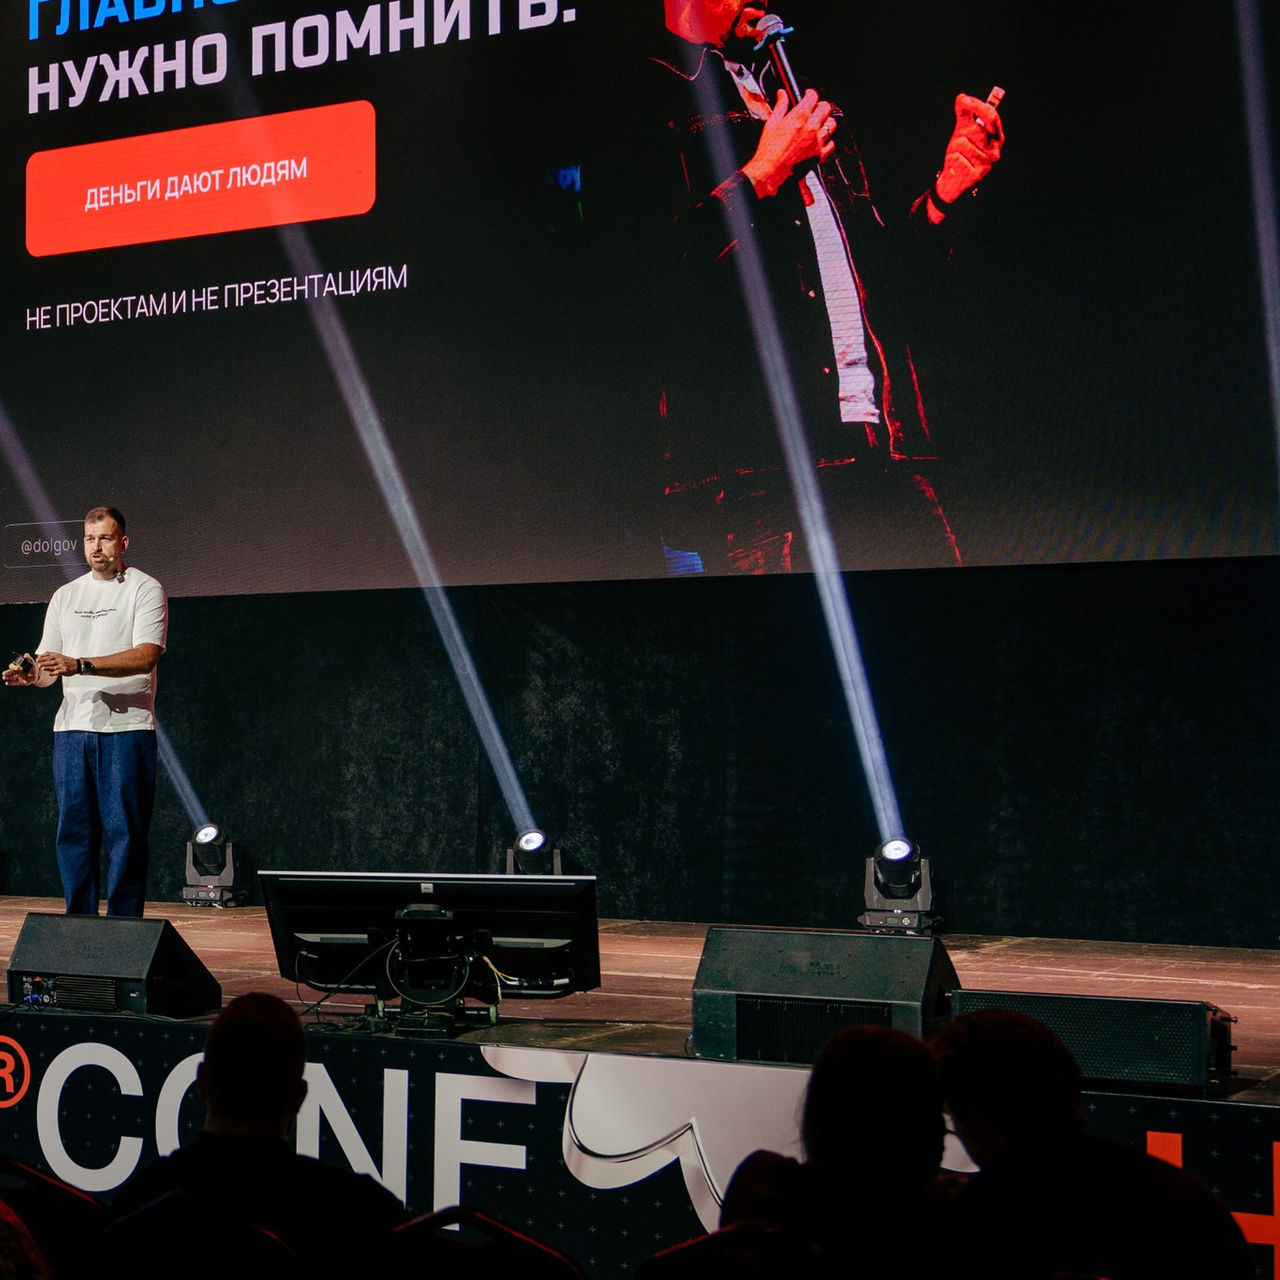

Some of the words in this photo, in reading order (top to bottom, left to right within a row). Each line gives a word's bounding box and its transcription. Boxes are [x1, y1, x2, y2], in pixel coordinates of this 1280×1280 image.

[28, 32, 228, 115] НУЖНО
[84, 178, 161, 212] ДЕНЬГИ
[164, 169, 224, 201] ДАЮТ
[226, 156, 308, 189] ЛЮДЯМ
[26, 305, 52, 331] НЕ
[56, 292, 168, 327] ПРОЕКТАМ
[172, 289, 188, 314] И
[191, 285, 219, 312] НЕ
[224, 263, 408, 308] ПРЕЗЕНТАЦИЯМ
[21, 537, 78, 556] @dolgov
